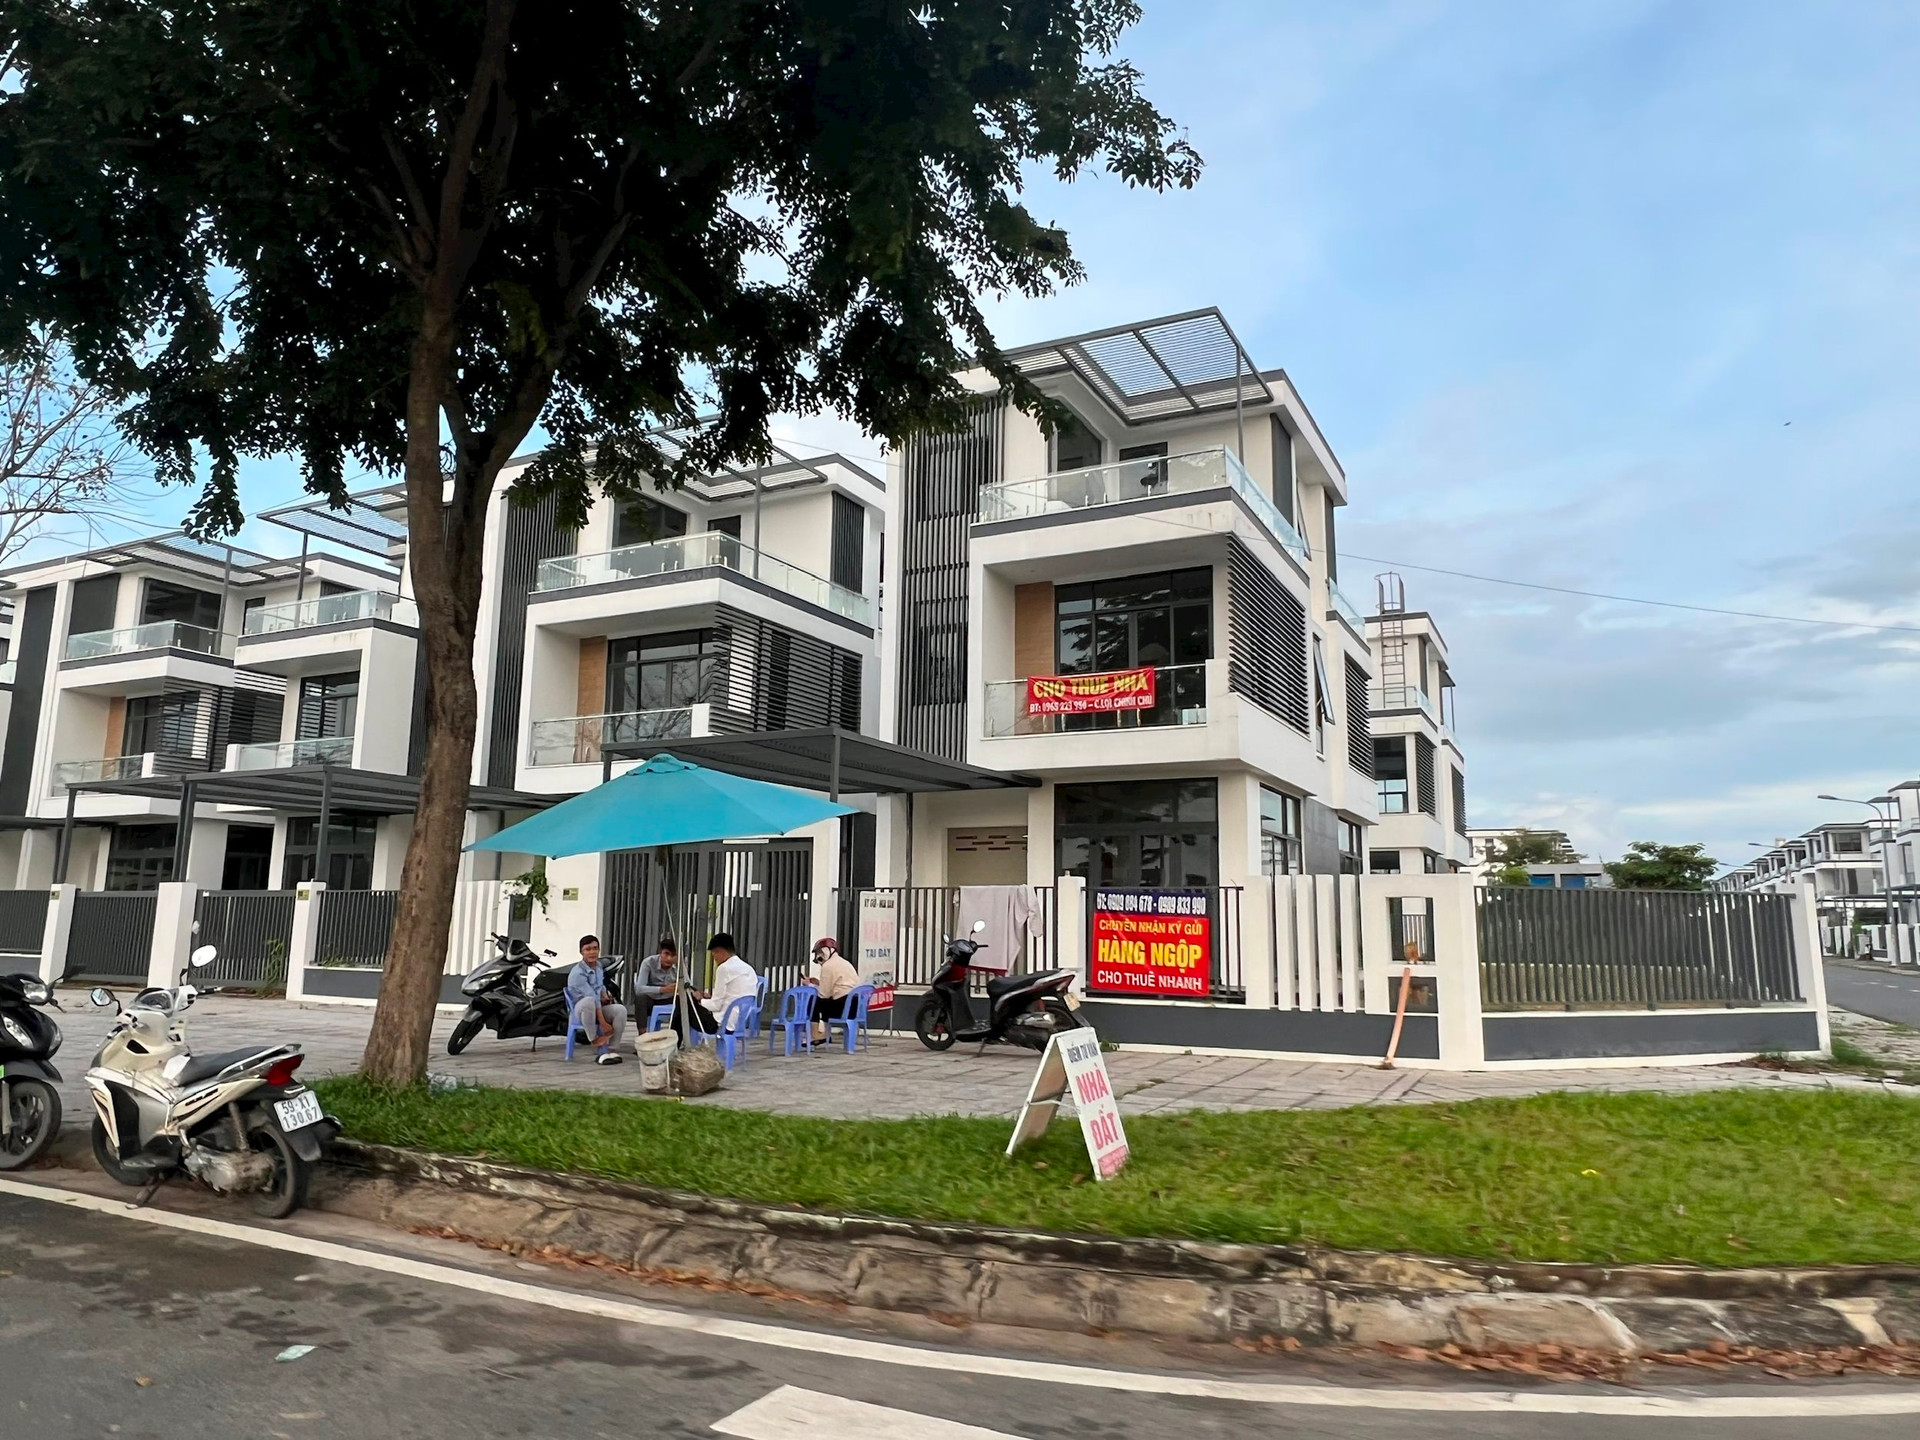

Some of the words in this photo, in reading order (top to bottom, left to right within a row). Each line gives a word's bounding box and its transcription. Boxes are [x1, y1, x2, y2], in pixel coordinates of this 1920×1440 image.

[1033, 680, 1066, 698] CHO
[1139, 895, 1153, 913] 678
[1139, 920, 1165, 935] NHẬN
[1098, 936, 1146, 965] HÀNG
[1150, 938, 1202, 973] NGỘP
[1097, 970, 1122, 985] CHO
[1124, 971, 1156, 987] THUÊ
[1158, 975, 1202, 990] NHANH
[1076, 1062, 1109, 1105] NHÀ
[1090, 1104, 1119, 1151] ĐẤT
